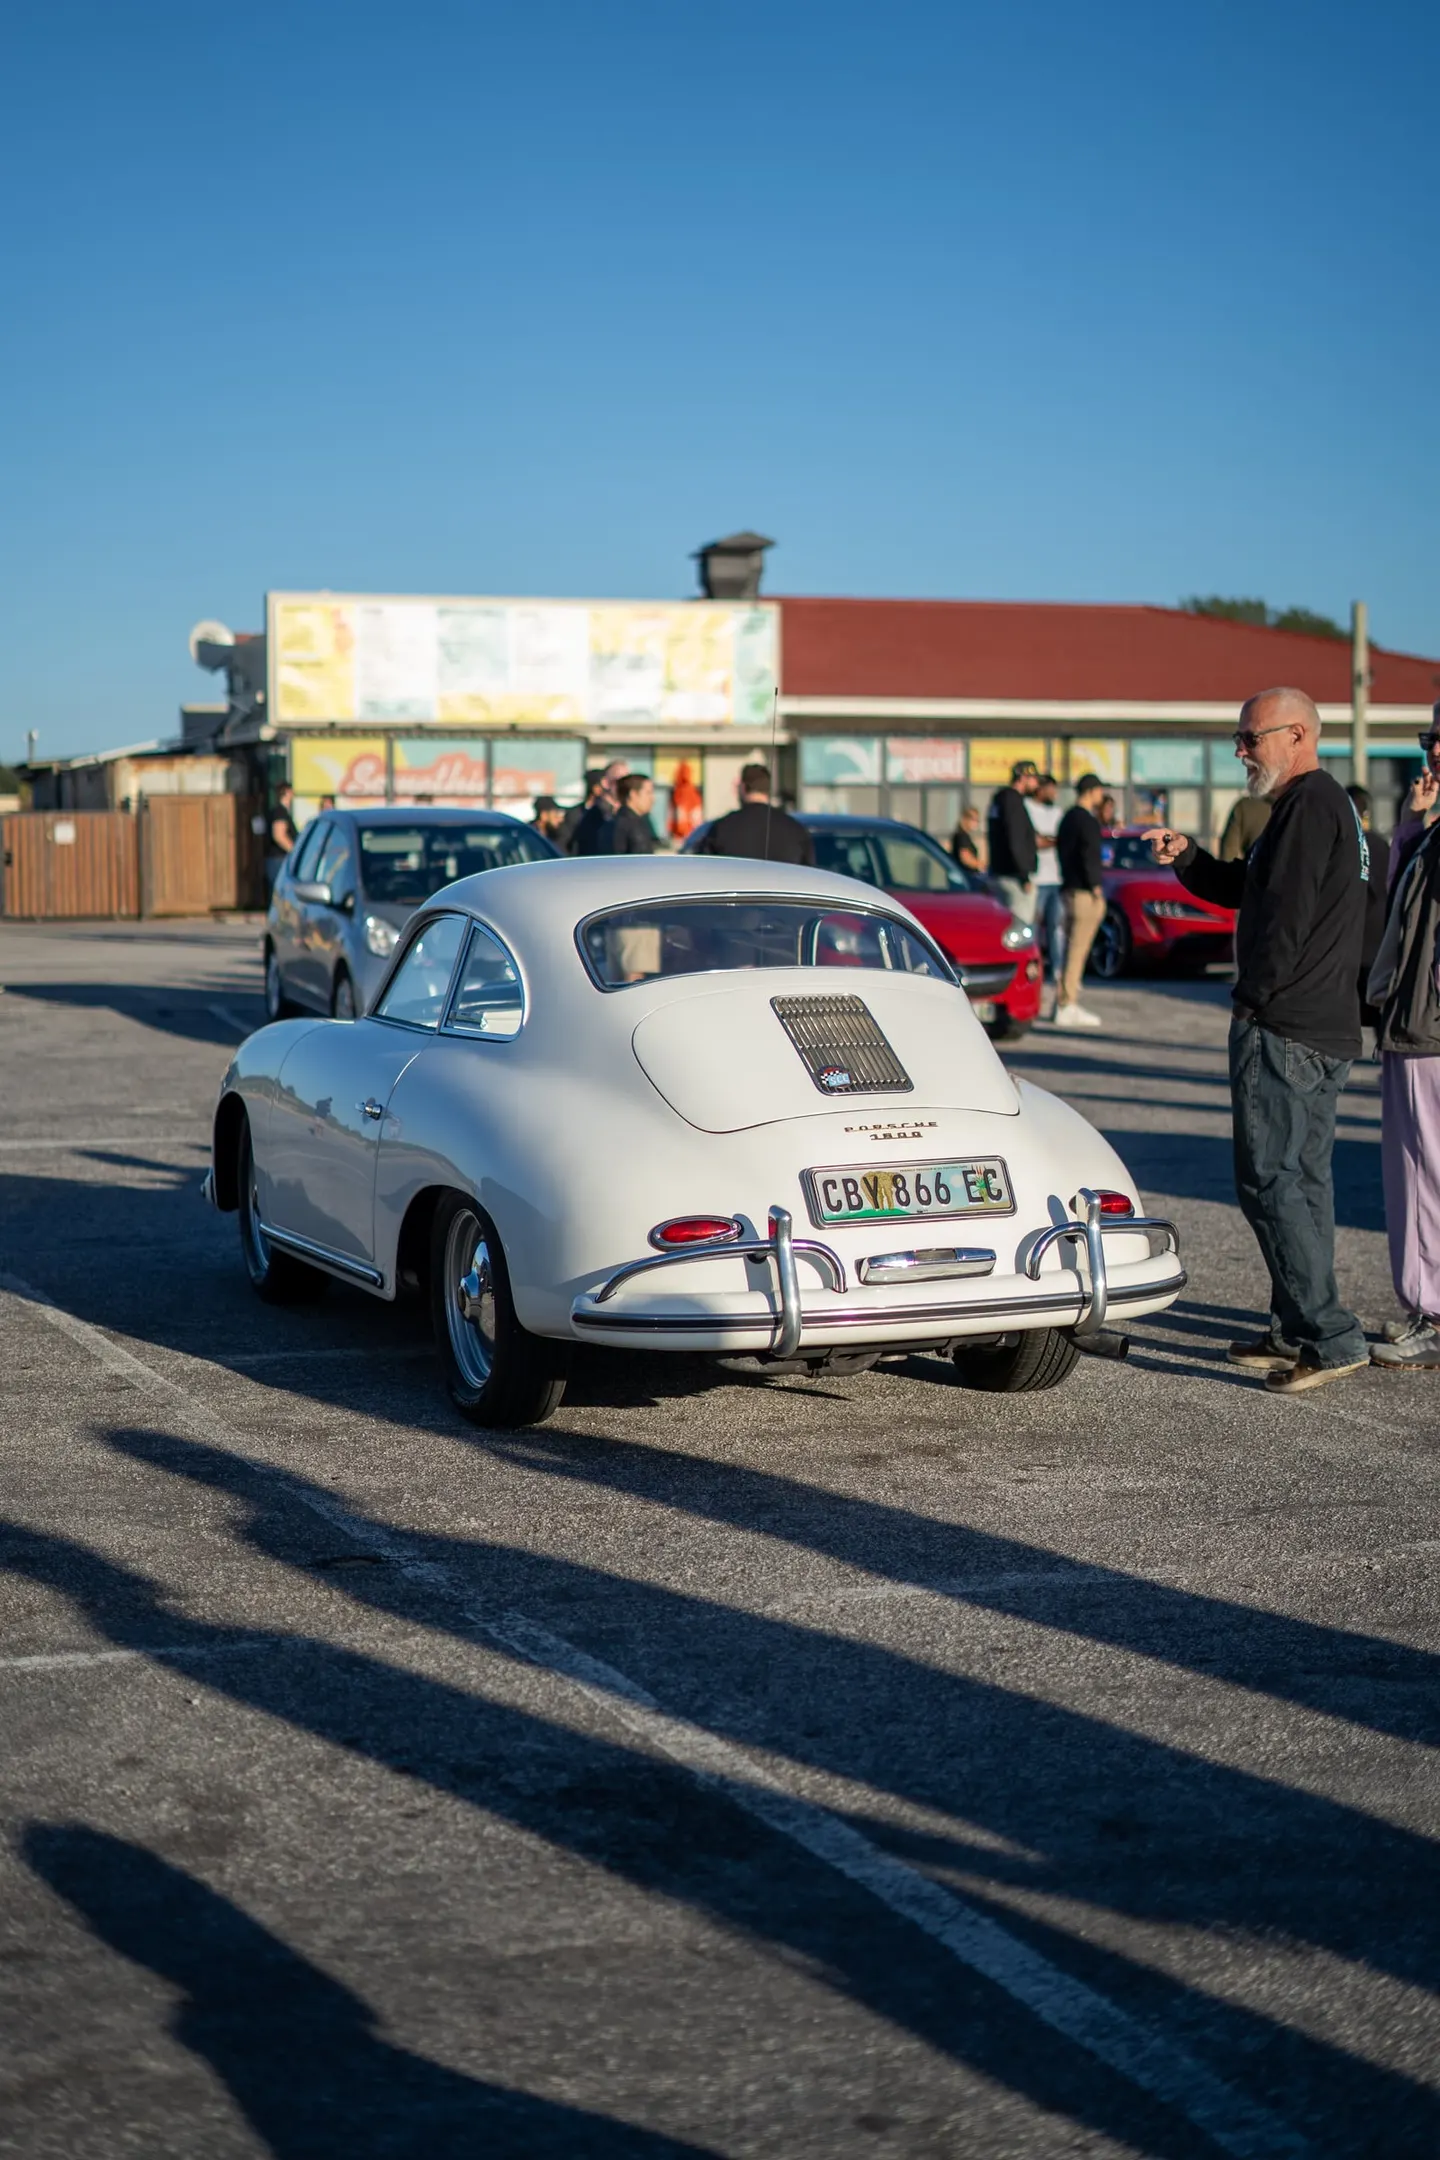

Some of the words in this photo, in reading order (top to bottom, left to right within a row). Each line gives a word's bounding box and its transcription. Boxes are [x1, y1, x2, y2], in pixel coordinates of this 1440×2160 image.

[844, 1121, 938, 1133] PORSCHE
[821, 1176, 879, 1213] CBY
[892, 1172, 951, 1207] 866
[962, 1168, 1003, 1203] EC
